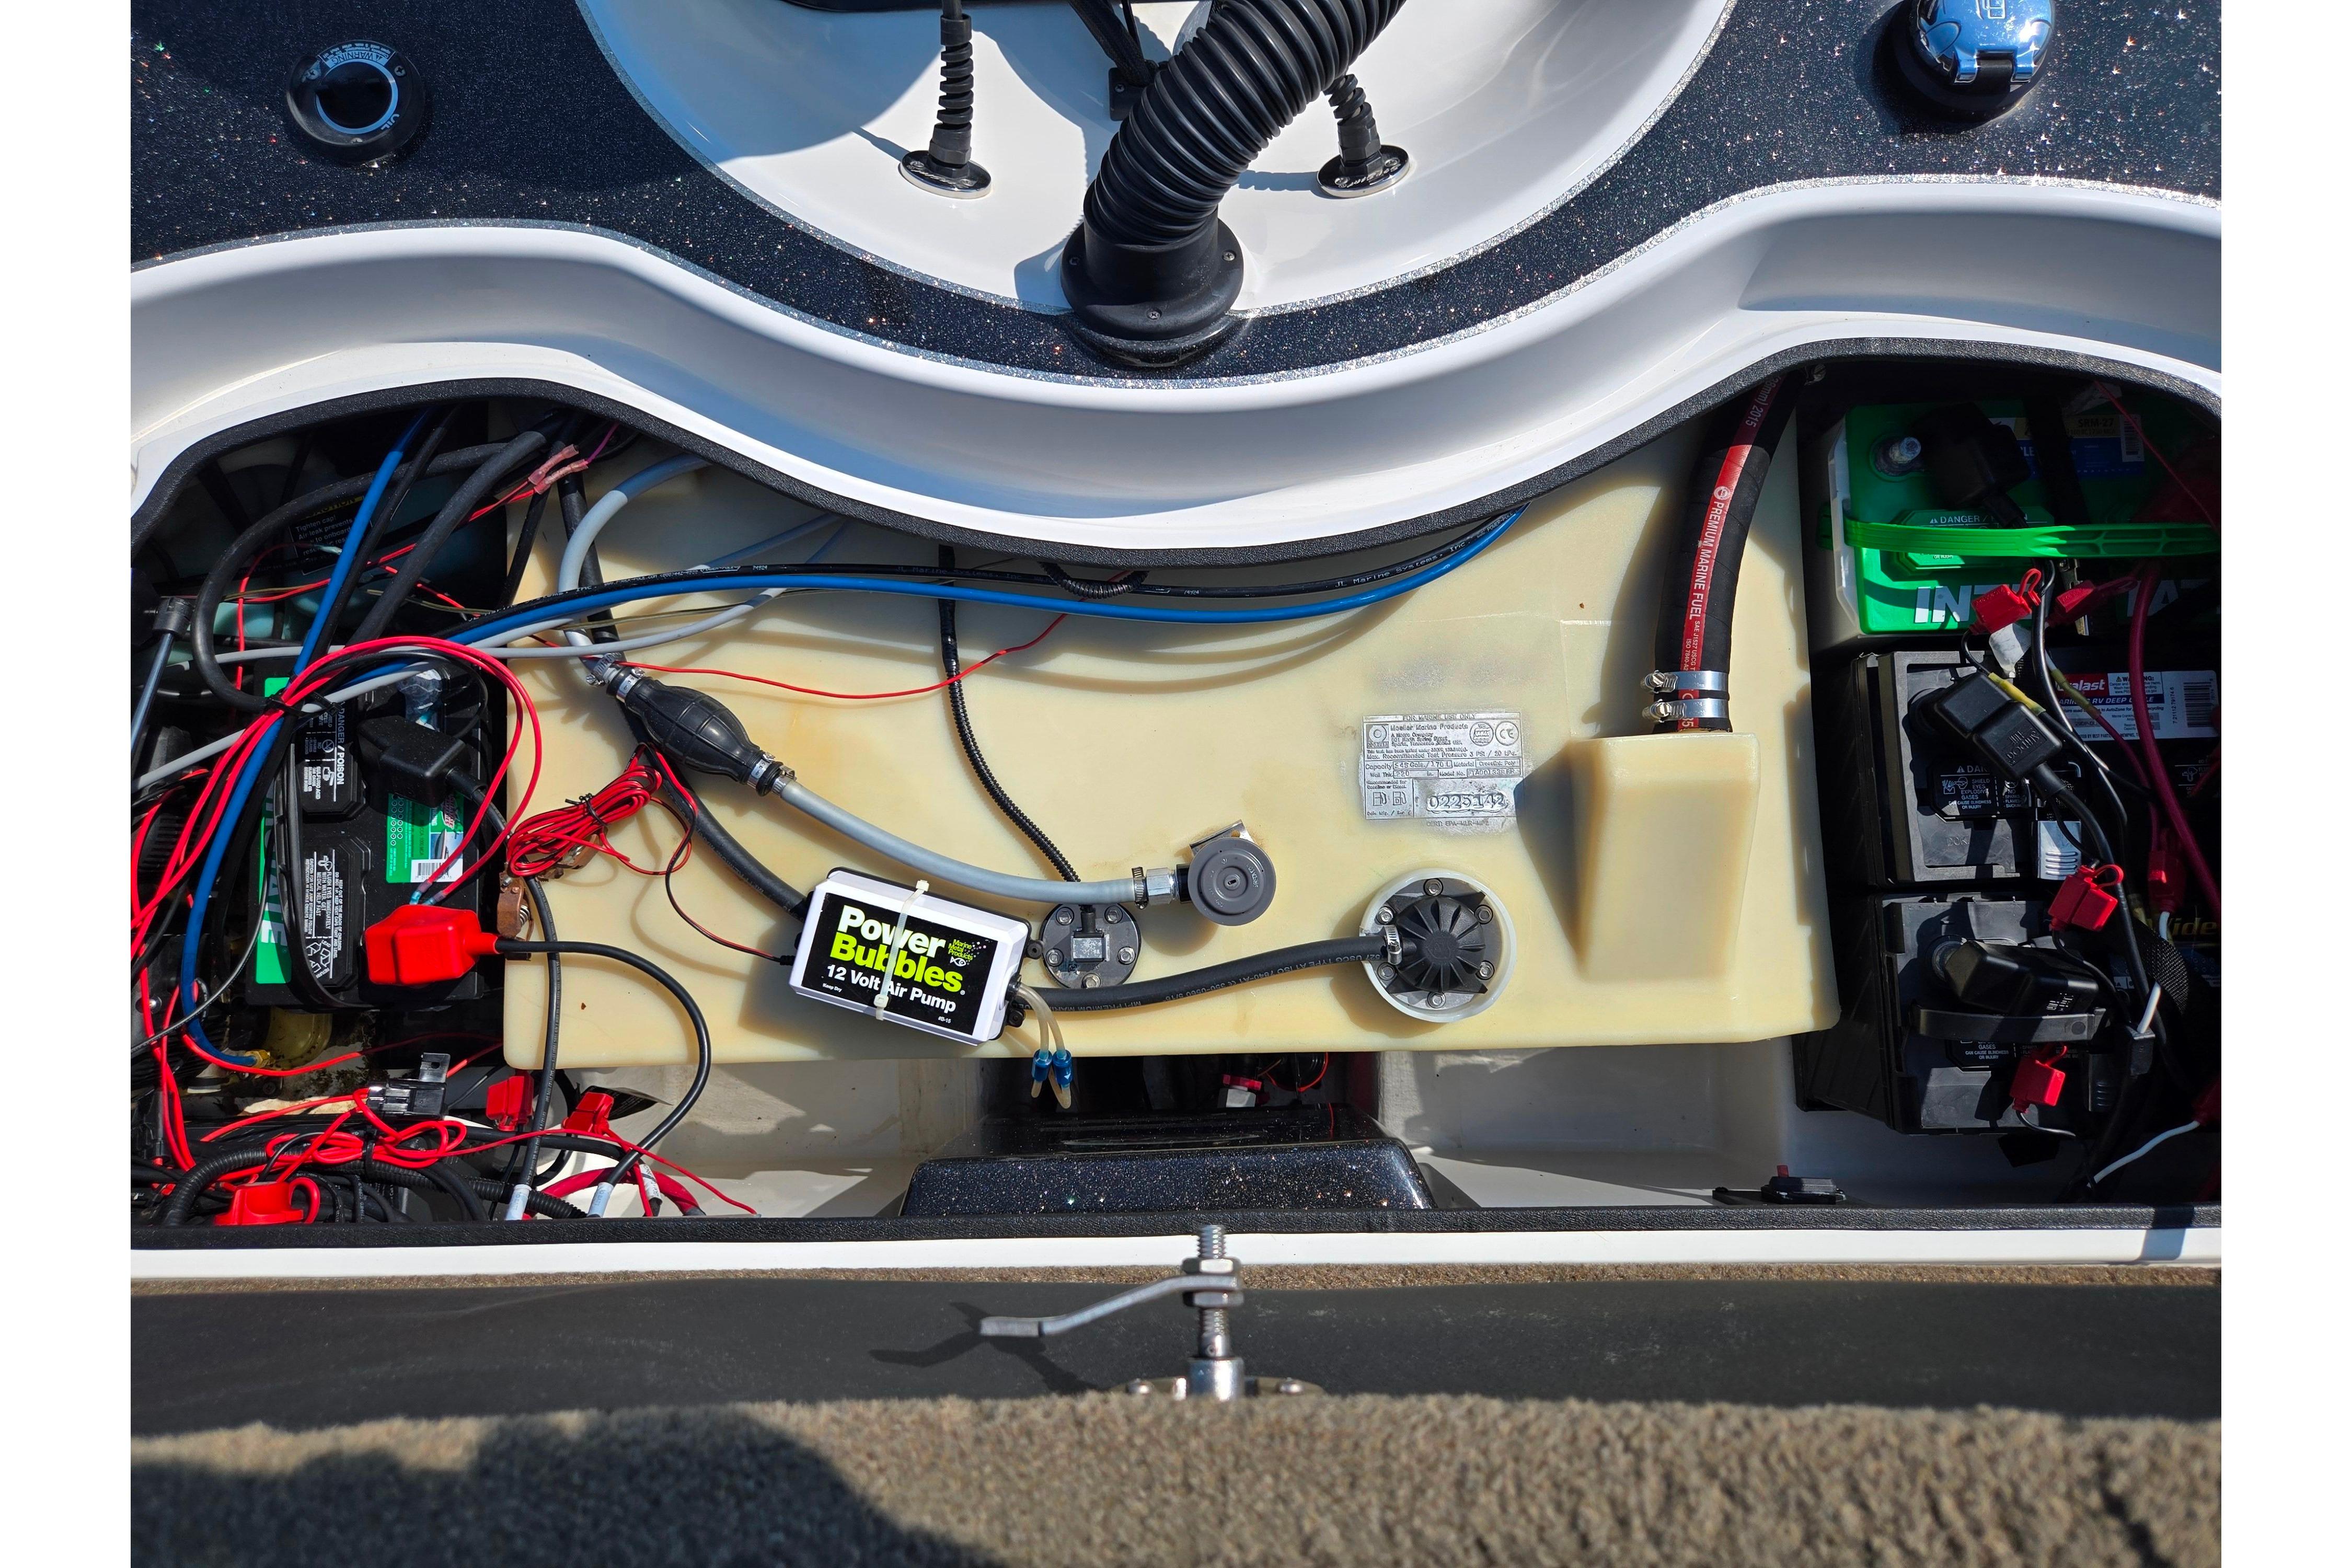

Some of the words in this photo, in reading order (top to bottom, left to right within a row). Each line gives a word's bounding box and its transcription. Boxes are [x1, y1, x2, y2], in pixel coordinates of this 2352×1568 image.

[331, 51, 373, 64] WARNING
[1745, 406, 1764, 428] 2015
[1703, 501, 1724, 547] PREMIUM
[1693, 549, 1712, 590] MARINE
[1353, 571, 1390, 584] Marine
[1689, 592, 1703, 620] FUEL
[1429, 793, 1504, 808] 0225142
[837, 905, 946, 958] Power
[948, 943, 964, 952] Metal
[953, 939, 972, 949] Marine
[948, 950, 973, 961] Products
[1336, 954, 1363, 963] USCG
[1309, 959, 1333, 967] TYPE
[827, 964, 847, 981] 12
[851, 970, 881, 990] Volt
[888, 981, 908, 997] Air
[909, 987, 956, 1013] Pump
